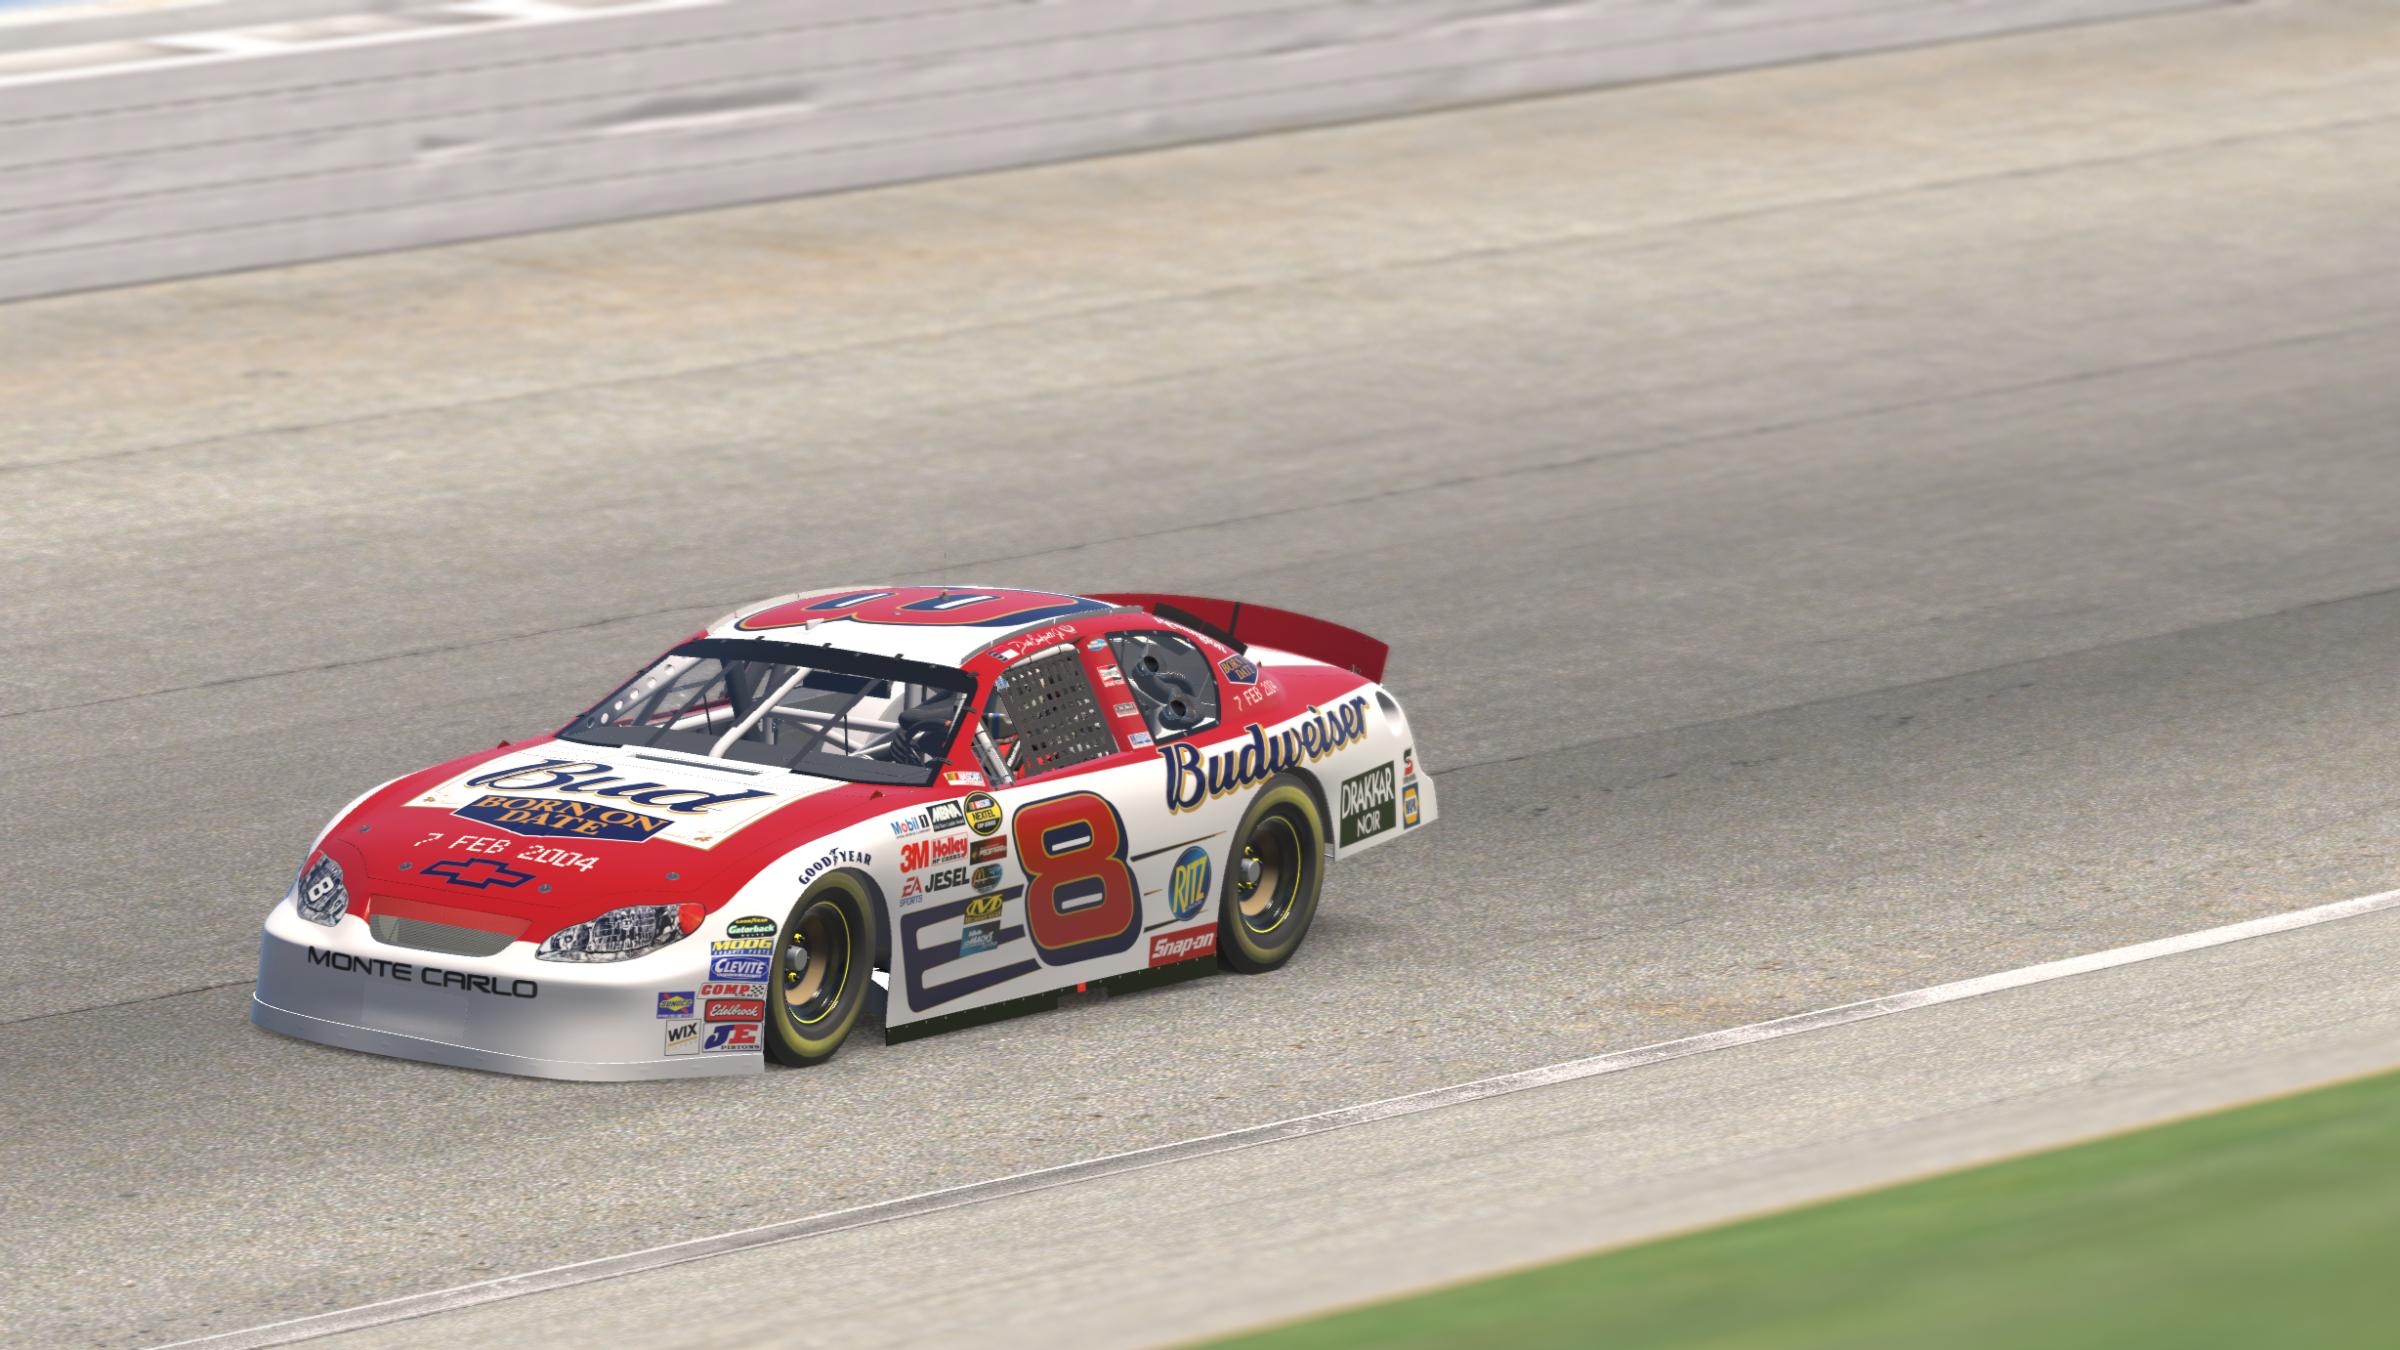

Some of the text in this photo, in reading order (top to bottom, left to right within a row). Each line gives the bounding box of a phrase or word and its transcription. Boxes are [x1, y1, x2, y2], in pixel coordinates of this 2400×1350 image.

[1233, 695, 1243, 711] 7
[1243, 686, 1263, 706] FEB
[1158, 696, 1370, 815] Budweiser
[464, 759, 778, 815] Bud
[1342, 767, 1394, 820] DRAKKAR
[475, 795, 666, 833] BORN ON
[496, 810, 609, 835] DATE
[890, 815, 920, 836] Mobil
[972, 810, 996, 821] NEXTEL
[1357, 810, 1381, 838] NOIR
[413, 832, 600, 872] 7 FEB 2004
[900, 840, 929, 873] 3M
[932, 836, 968, 858] Holley
[308, 876, 334, 902] 8
[901, 876, 922, 898] EA
[924, 866, 970, 893] JESEL
[1012, 790, 1143, 967] 8
[1172, 855, 1207, 913] RITZ
[712, 938, 772, 951] MOOG
[1152, 932, 1214, 959] Snap-on
[308, 946, 538, 999] MONTE CARLO
[714, 958, 766, 974] CLEVITE
[701, 984, 750, 996] COMP
[710, 1003, 759, 1017] Edelbrock
[668, 1022, 697, 1042] WIX
[704, 1023, 758, 1050] JE
